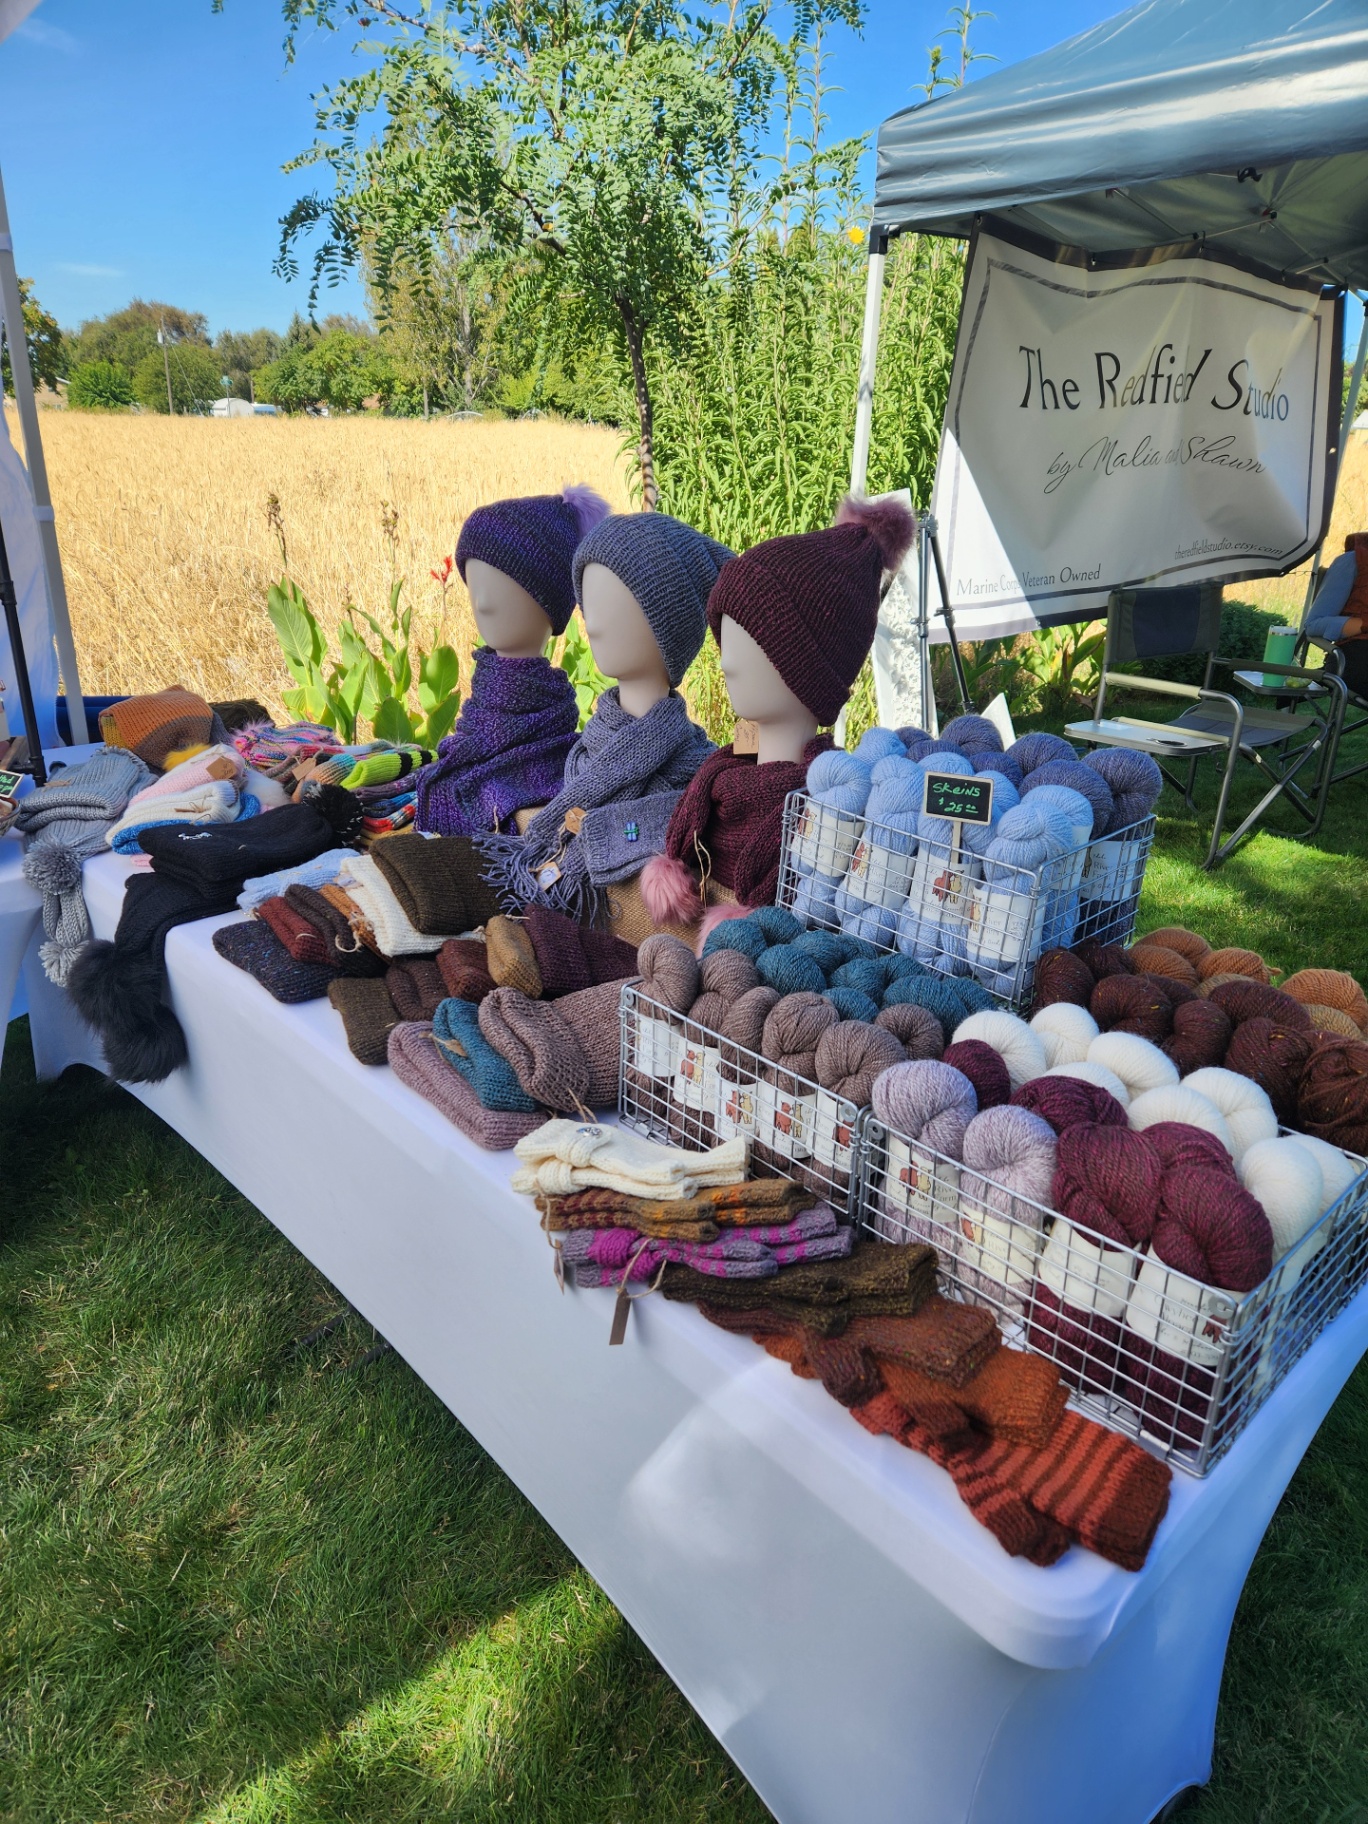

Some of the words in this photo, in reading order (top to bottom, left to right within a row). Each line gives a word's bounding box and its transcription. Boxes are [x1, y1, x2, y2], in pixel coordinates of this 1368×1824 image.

[1019, 345, 1081, 410] The
[1211, 359, 1289, 421] Studio
[1043, 452, 1078, 494] by
[1078, 436, 1162, 475] Malia
[1180, 435, 1266, 473] Shawn
[1174, 537, 1284, 560] theredfieldstudio.etsy.com
[956, 578, 998, 596] Marine
[1022, 571, 1055, 588] Veteran
[1060, 563, 1101, 583] Owned
